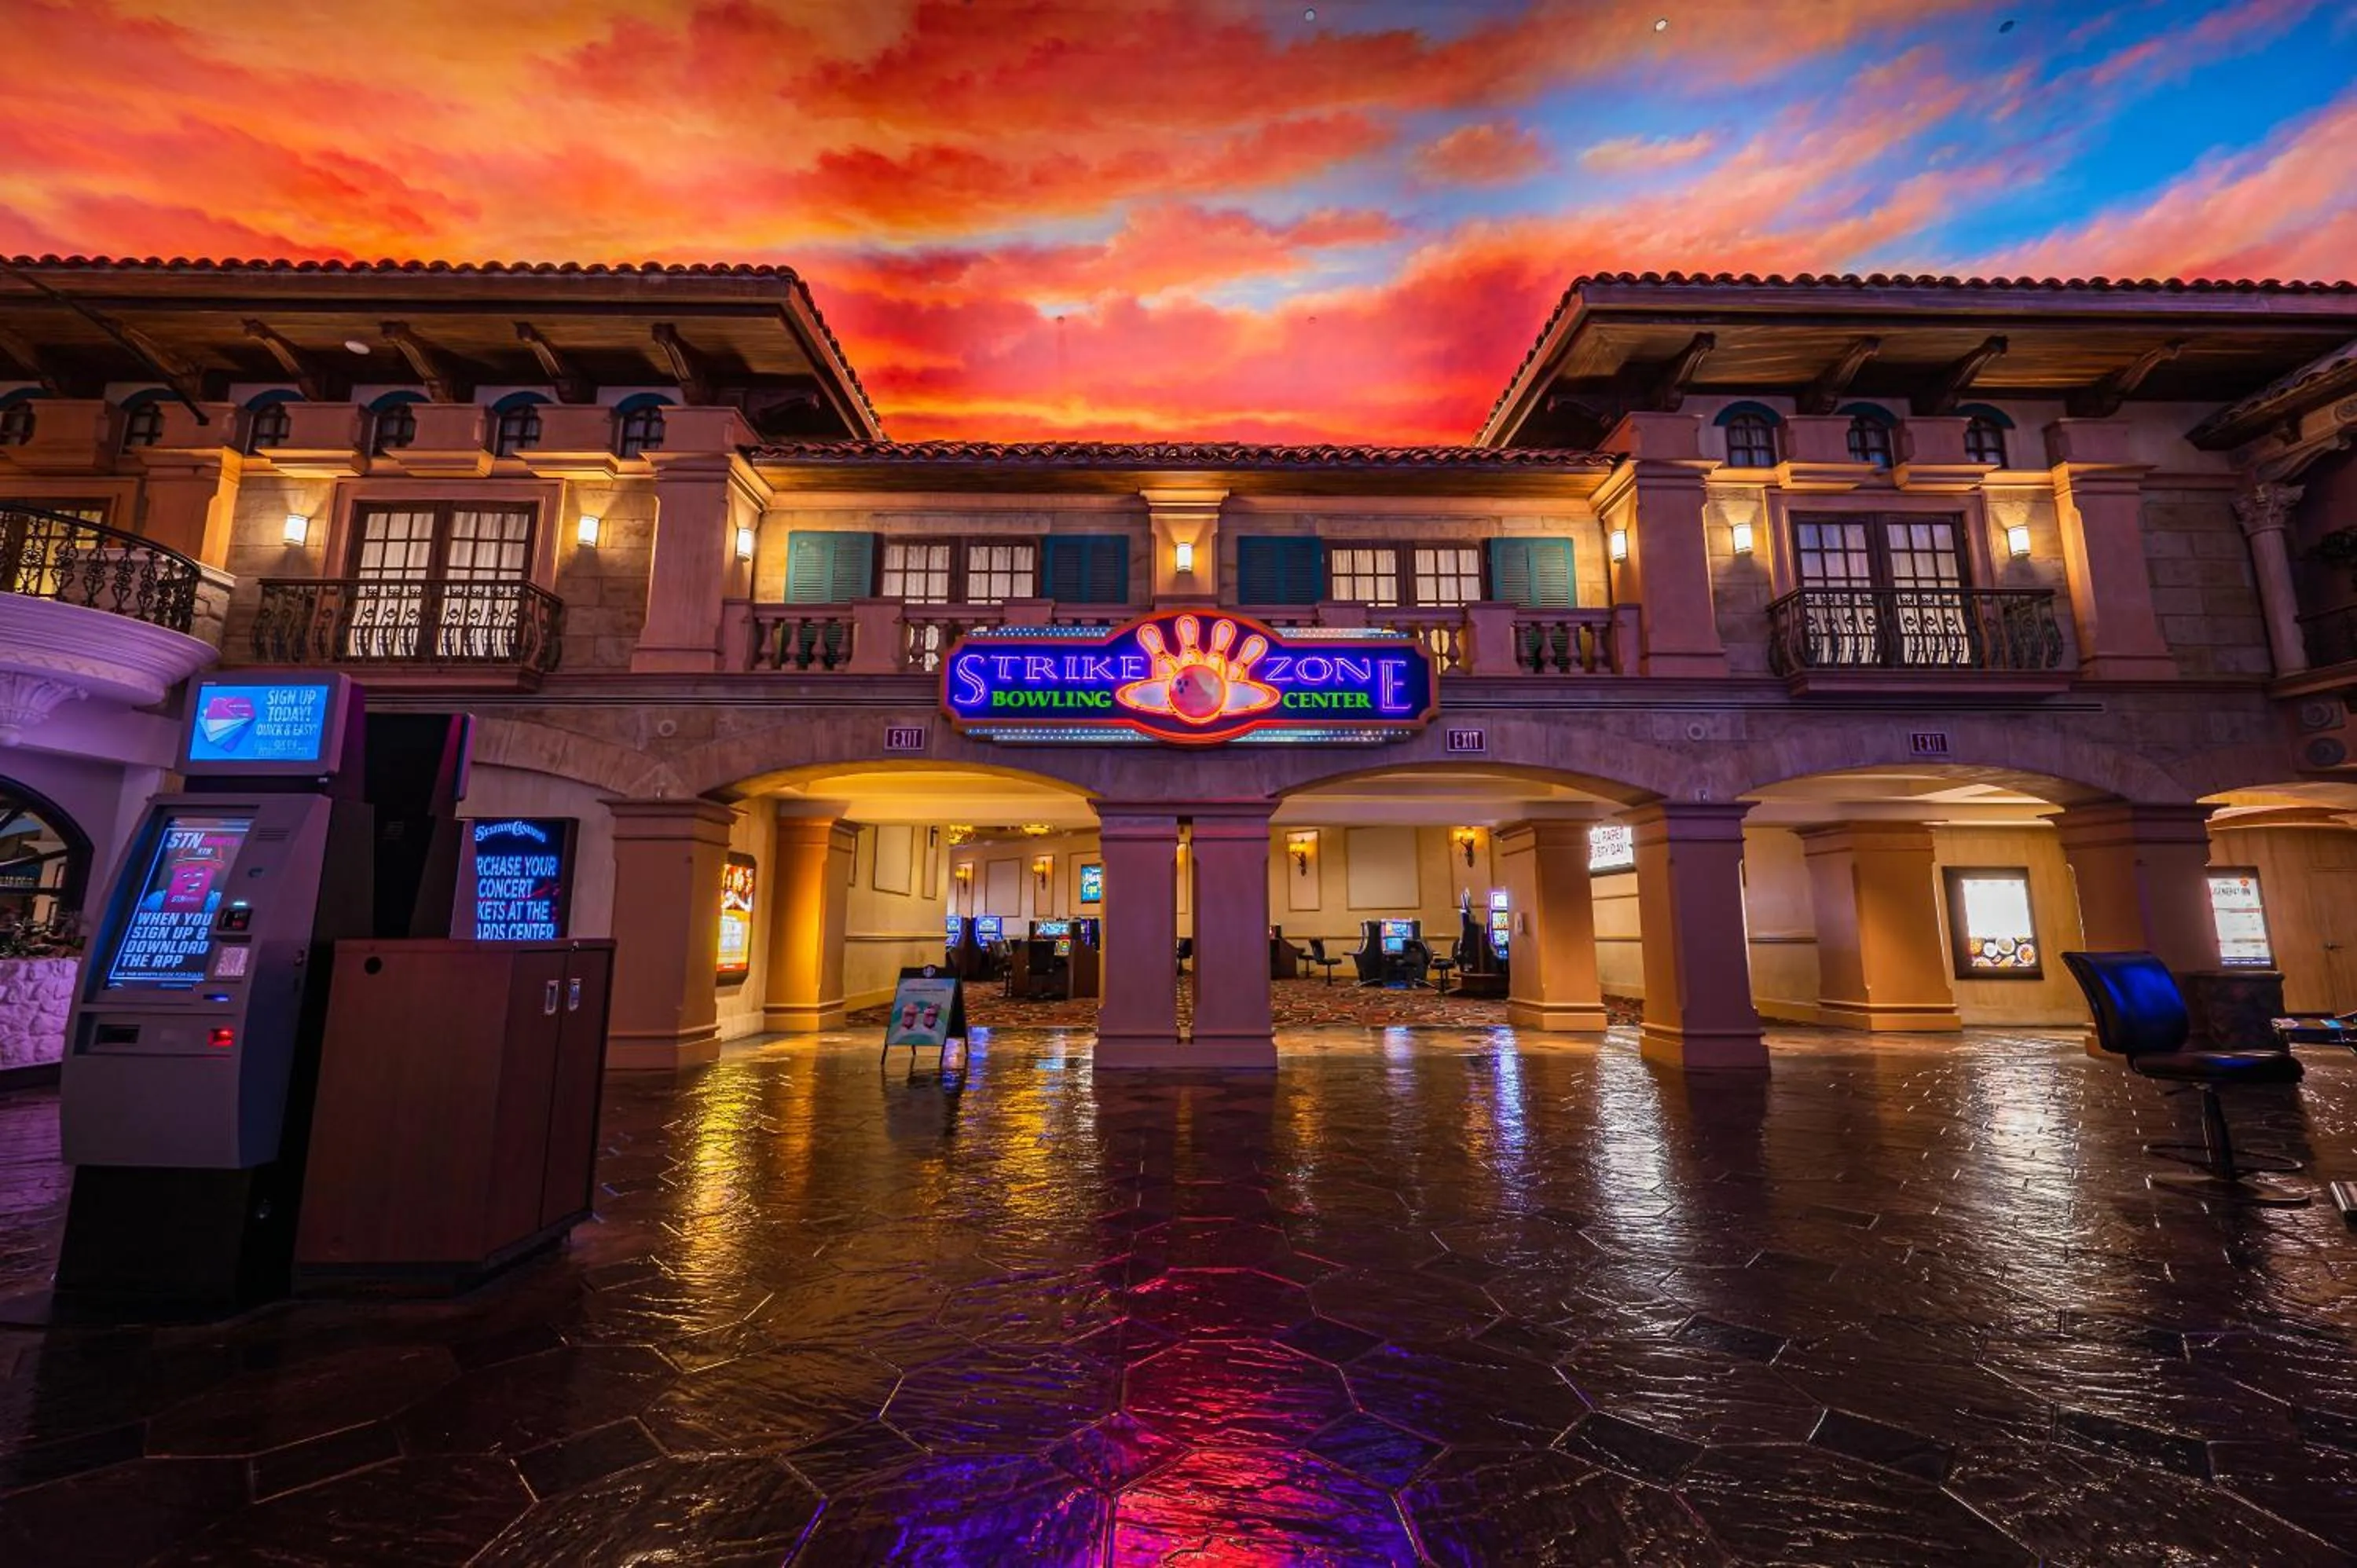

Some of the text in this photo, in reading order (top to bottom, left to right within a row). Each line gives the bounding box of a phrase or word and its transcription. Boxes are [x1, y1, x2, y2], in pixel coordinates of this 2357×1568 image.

[953, 654, 1413, 711] STRIKE ZONE
[266, 690, 317, 705] SIGN UP
[991, 691, 1373, 709] BOWLING CENTER
[268, 706, 313, 722] TODAY!
[893, 731, 918, 748] EXIT
[1454, 731, 1479, 749] EXIT
[1917, 735, 1942, 752] EXIT
[166, 832, 205, 848] STN
[477, 855, 558, 877] RCHASE YOUR
[478, 877, 535, 899] CONCERT
[137, 912, 214, 926] WHEN YOU
[477, 901, 550, 921] KETS AT THE
[130, 926, 208, 940] SIGN UP &
[508, 923, 555, 940] CENTER
[125, 940, 210, 954] DOWNLOAD
[121, 954, 185, 968] THE APP
